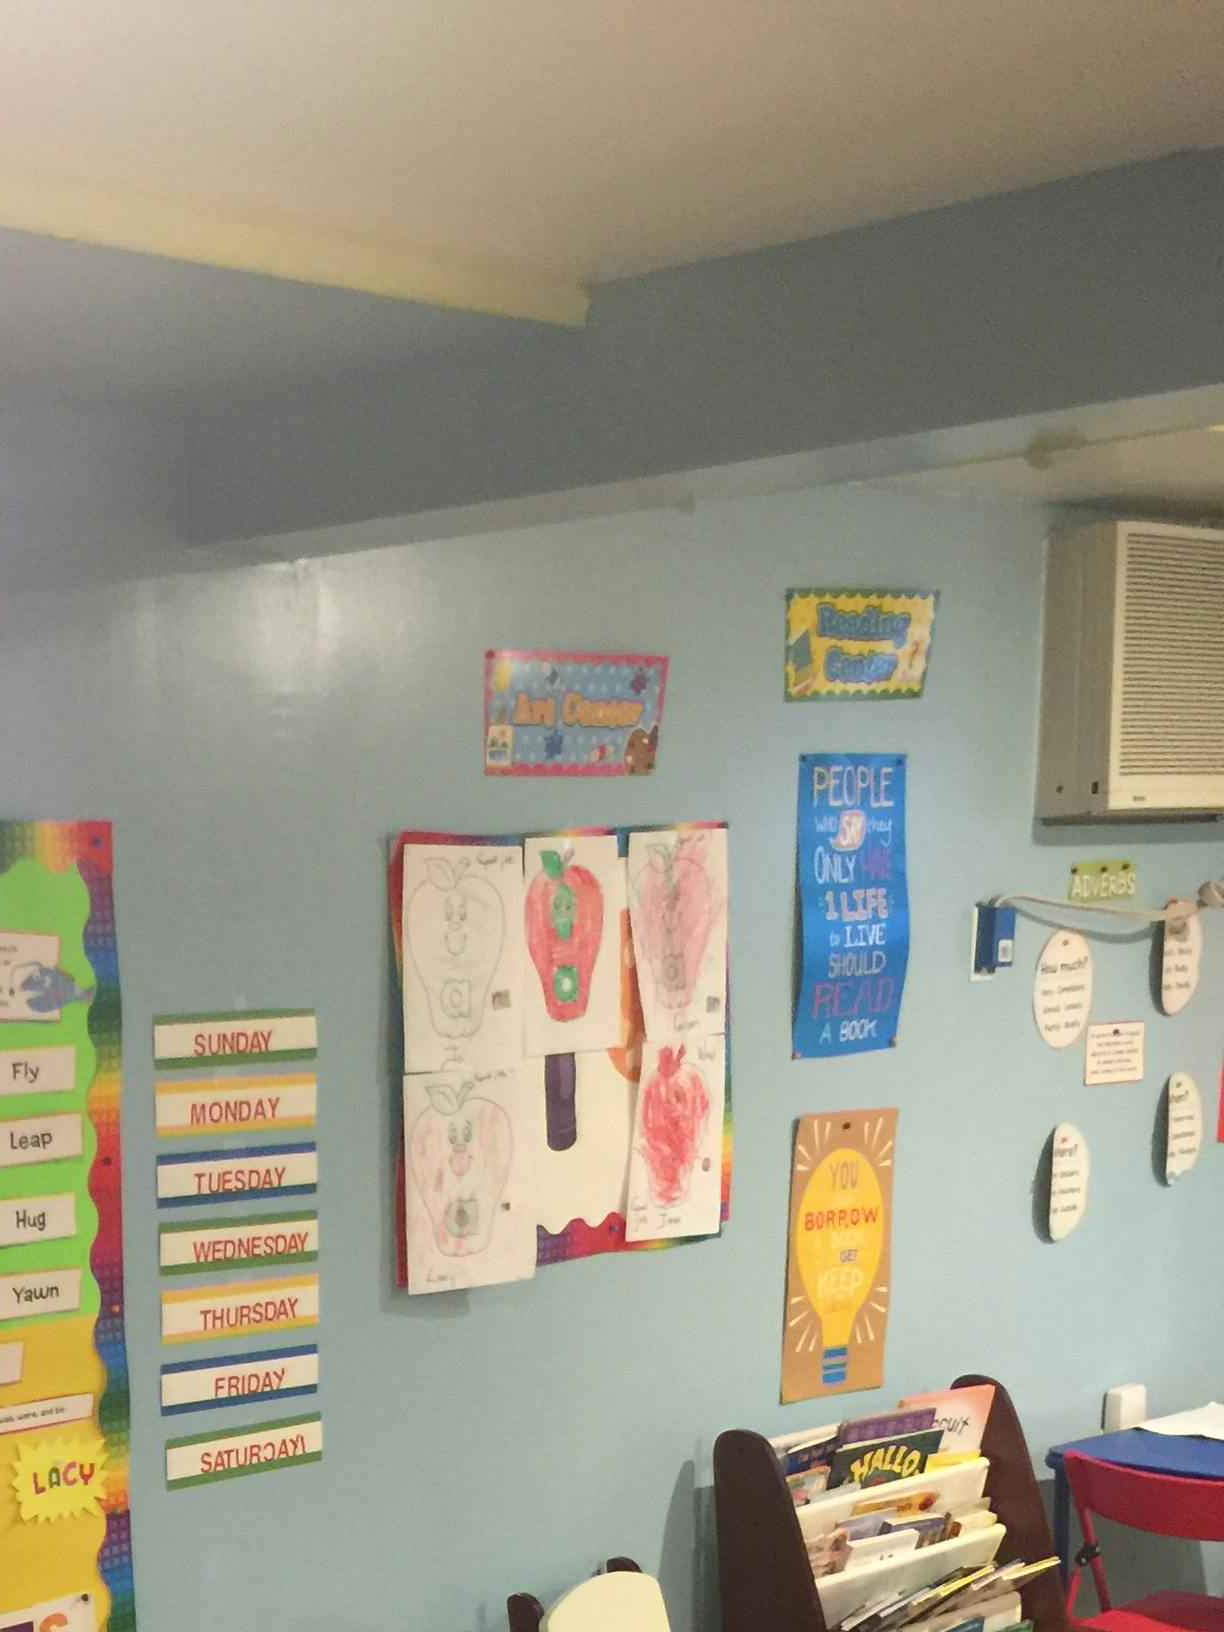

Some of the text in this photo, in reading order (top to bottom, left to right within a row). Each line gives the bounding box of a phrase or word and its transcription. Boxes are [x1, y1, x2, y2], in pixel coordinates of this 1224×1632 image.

[812, 766, 895, 807] PEOPLE
[814, 846, 856, 885] ONLY
[1072, 872, 1136, 899] ADVERBS
[840, 887, 888, 922] LIFE
[844, 923, 887, 948] LIVE
[828, 952, 887, 978] SHOULD
[812, 976, 895, 1019] READ
[194, 1030, 273, 1057] SUNDAY
[819, 1019, 878, 1045] A BOOK
[12, 1063, 39, 1083] Fly
[190, 1097, 280, 1125] MONDAY
[10, 1131, 52, 1151] Leap
[194, 1167, 287, 1194] TUESDAY
[830, 1160, 860, 1191] YOU
[16, 1211, 46, 1231] Hug
[804, 1207, 878, 1232] BORROW
[192, 1232, 309, 1263] WEDNESDAY
[12, 1285, 59, 1303] Yawn
[200, 1297, 299, 1332] THURSDAY
[214, 1368, 286, 1399] FRIDAY
[850, 1445, 921, 1483] HALLO
[33, 1460, 96, 1496] LACY
